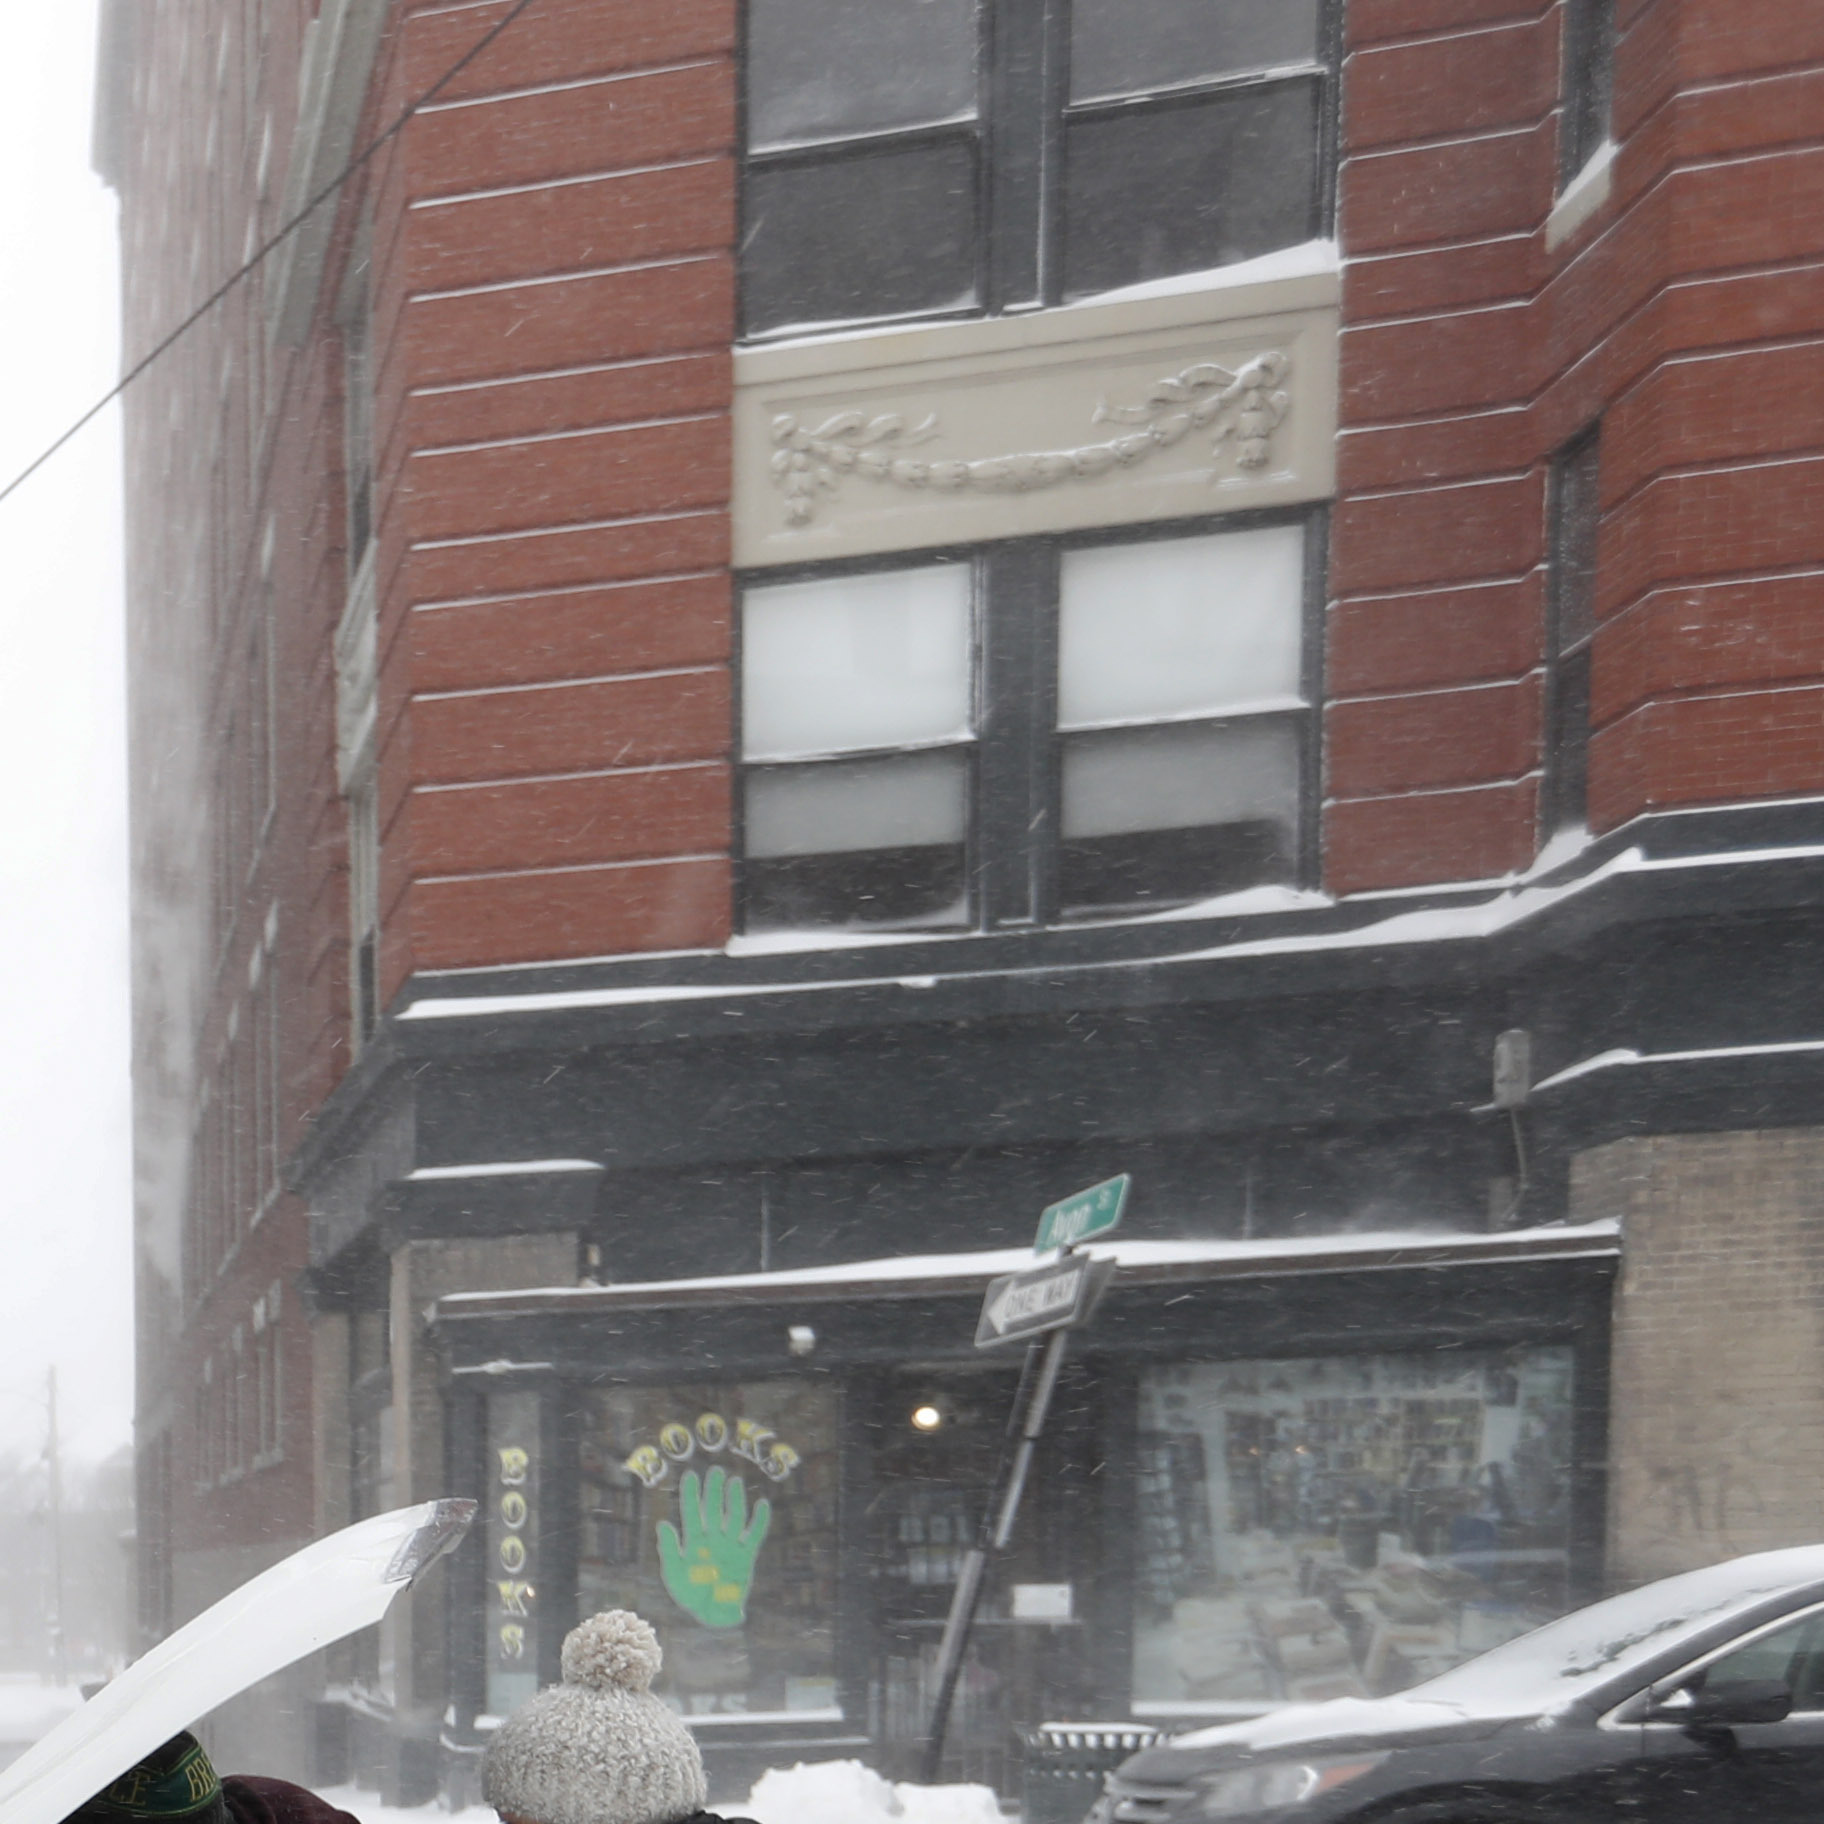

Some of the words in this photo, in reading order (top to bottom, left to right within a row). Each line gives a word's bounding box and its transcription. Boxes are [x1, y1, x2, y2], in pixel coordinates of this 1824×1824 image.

[1006, 1286, 1035, 1318] ONE
[1045, 1271, 1078, 1305] WAY
[621, 1411, 802, 1488] BOOKS
[497, 1445, 532, 1660] BOOKS
